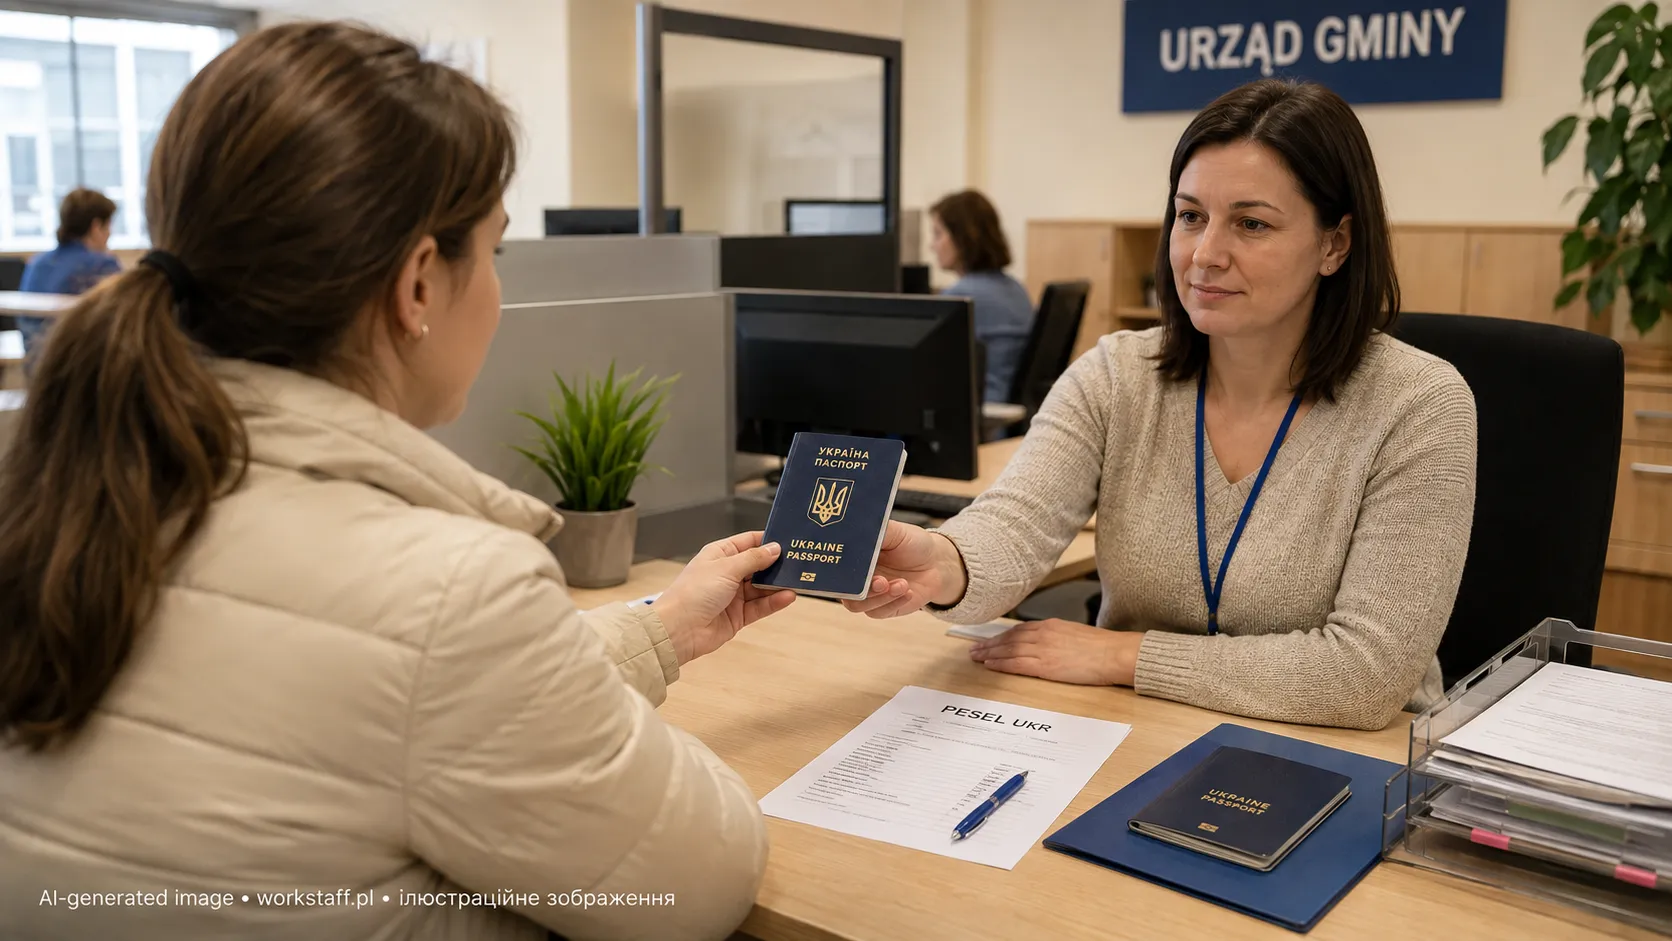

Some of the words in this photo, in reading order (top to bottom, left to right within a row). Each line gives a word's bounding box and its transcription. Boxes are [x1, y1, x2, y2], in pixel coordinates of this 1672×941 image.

[1159, 20, 1302, 76] URZĄD
[1314, 7, 1466, 63] GMINY
[818, 446, 870, 460] УКРАЇНА
[814, 458, 868, 471] ПАСПОРТ
[790, 539, 844, 553] UKRAINE
[786, 551, 842, 564] PASSPORT
[941, 705, 1005, 724] PESEL
[1012, 719, 1052, 732] UKR
[1200, 794, 1266, 815] PASSPORT
[1209, 788, 1271, 810] UKRAINE
